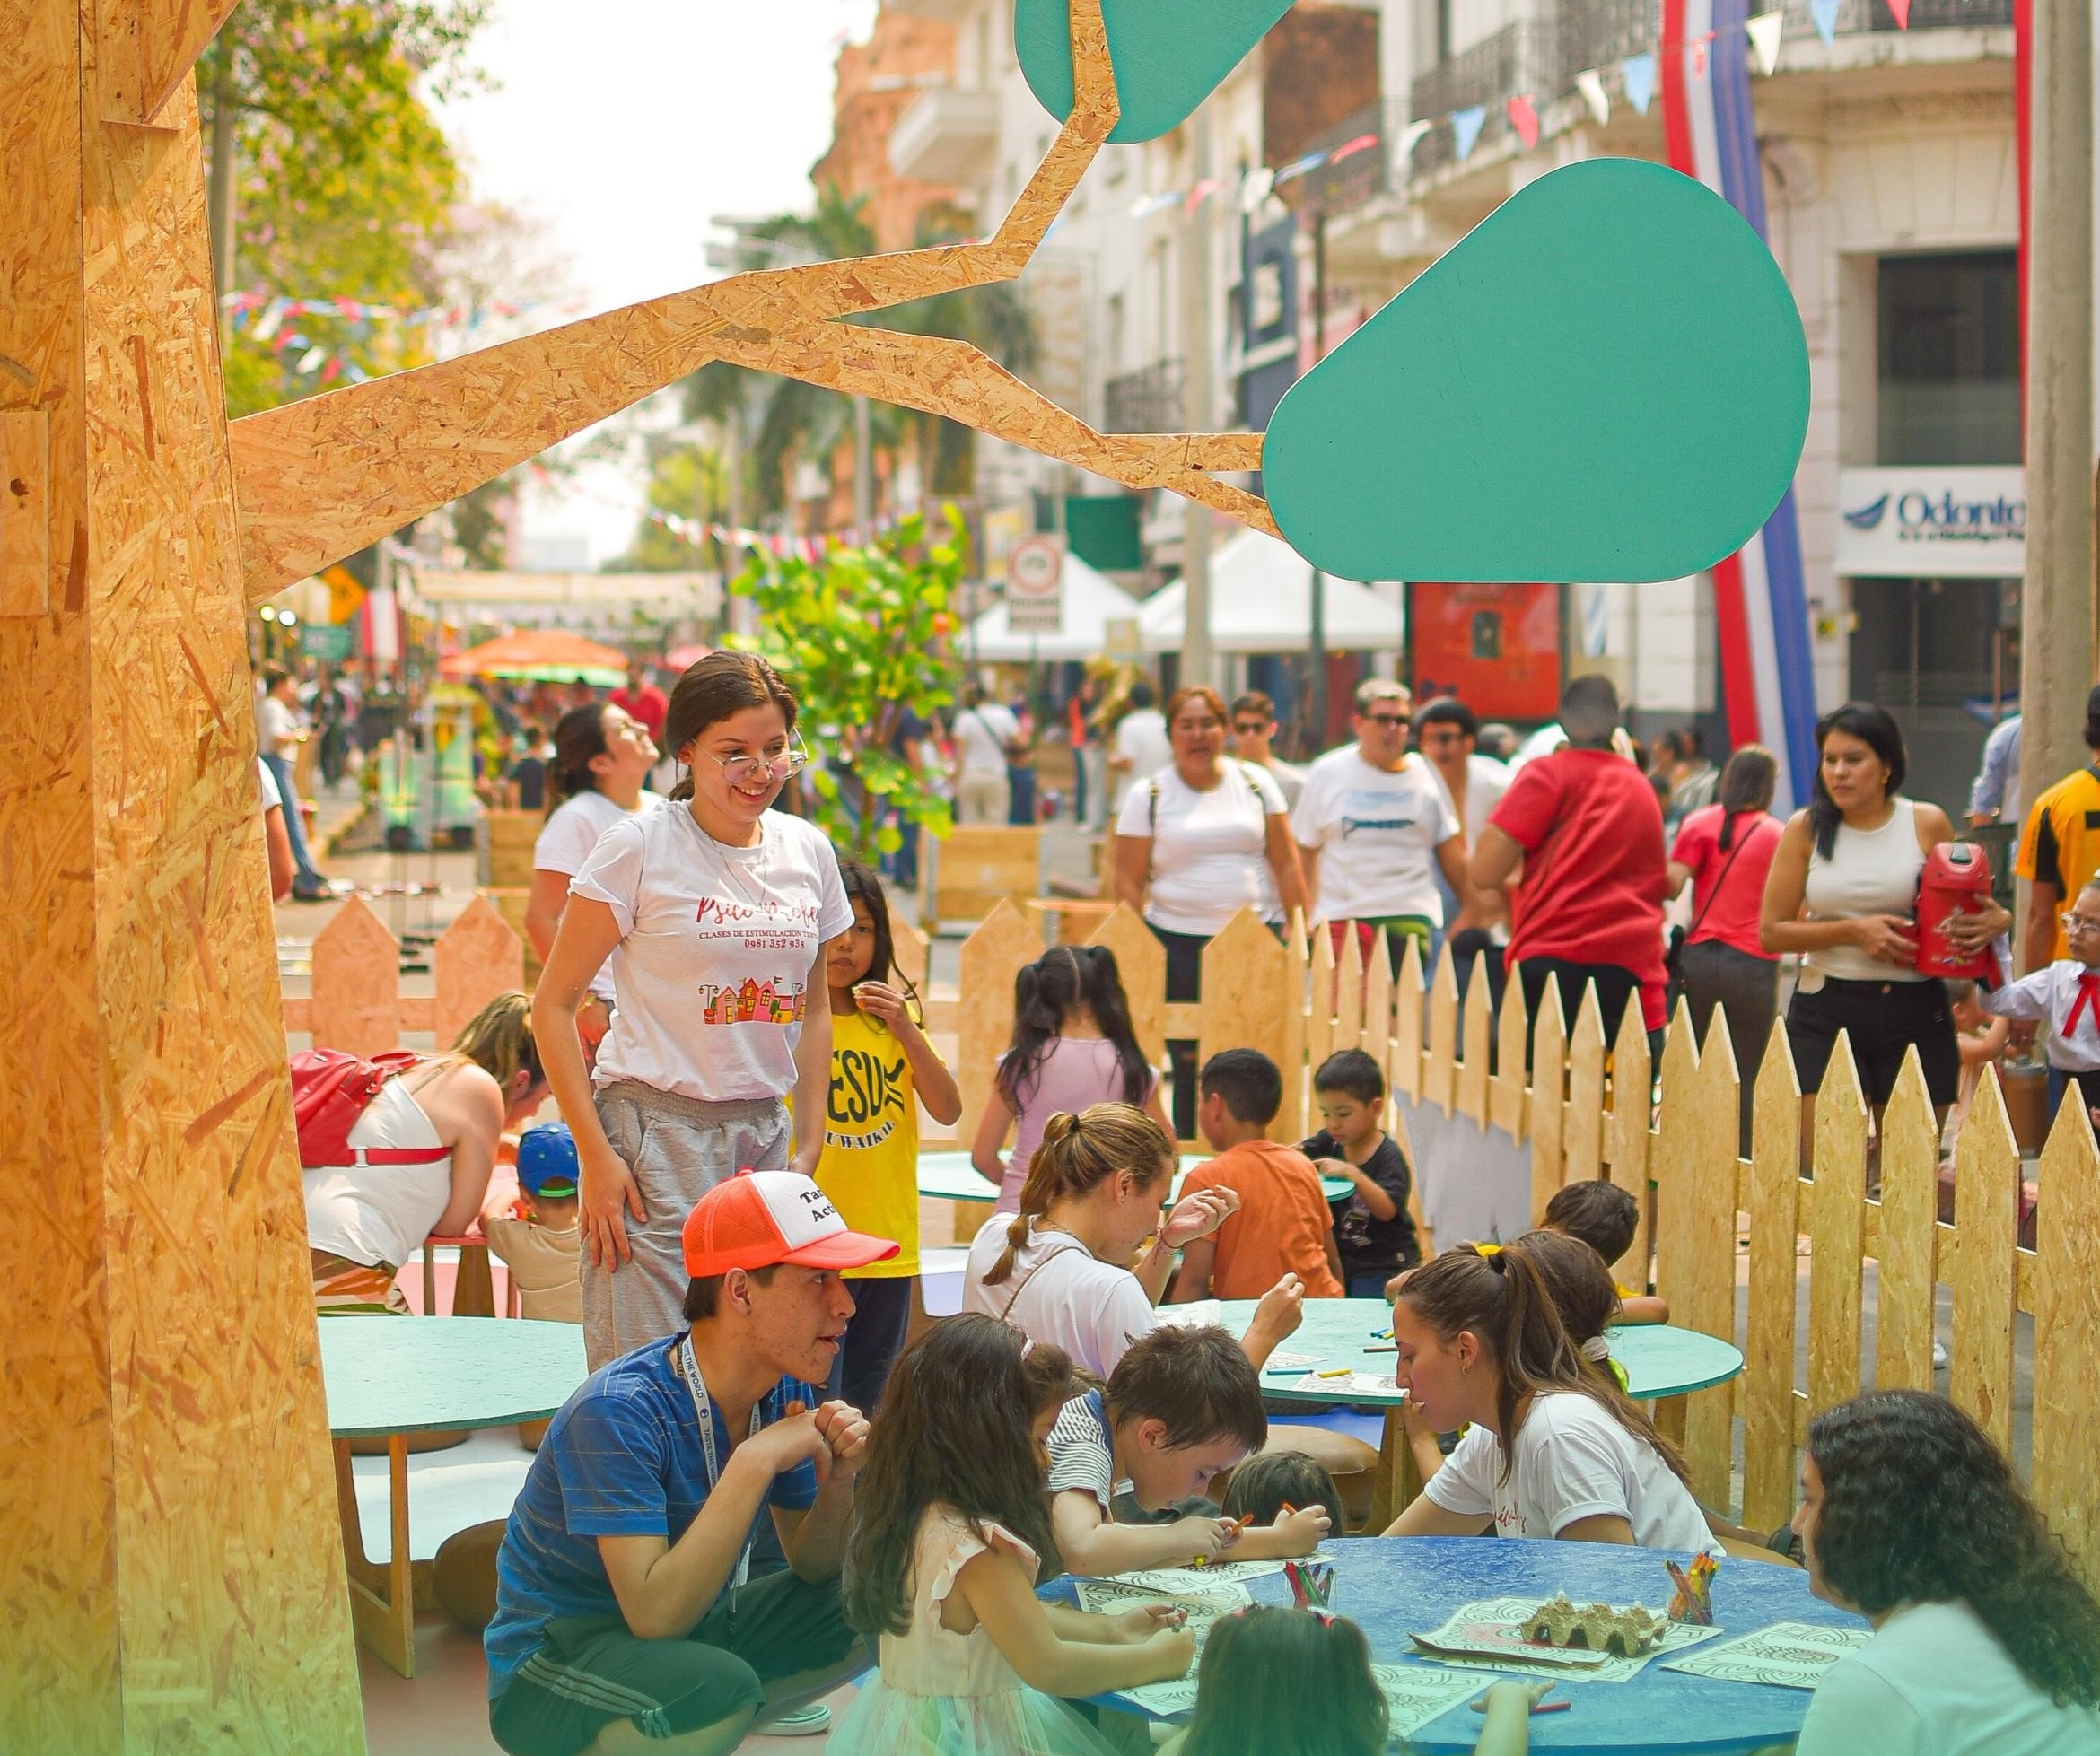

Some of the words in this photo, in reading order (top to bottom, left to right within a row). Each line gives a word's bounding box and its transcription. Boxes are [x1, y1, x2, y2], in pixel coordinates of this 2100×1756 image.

[699, 930, 731, 939] CLASES
[744, 939, 766, 949] 0981
[769, 939, 786, 949] 352
[686, 1358, 696, 1372] THE
[690, 1371, 704, 1399] WORLD
